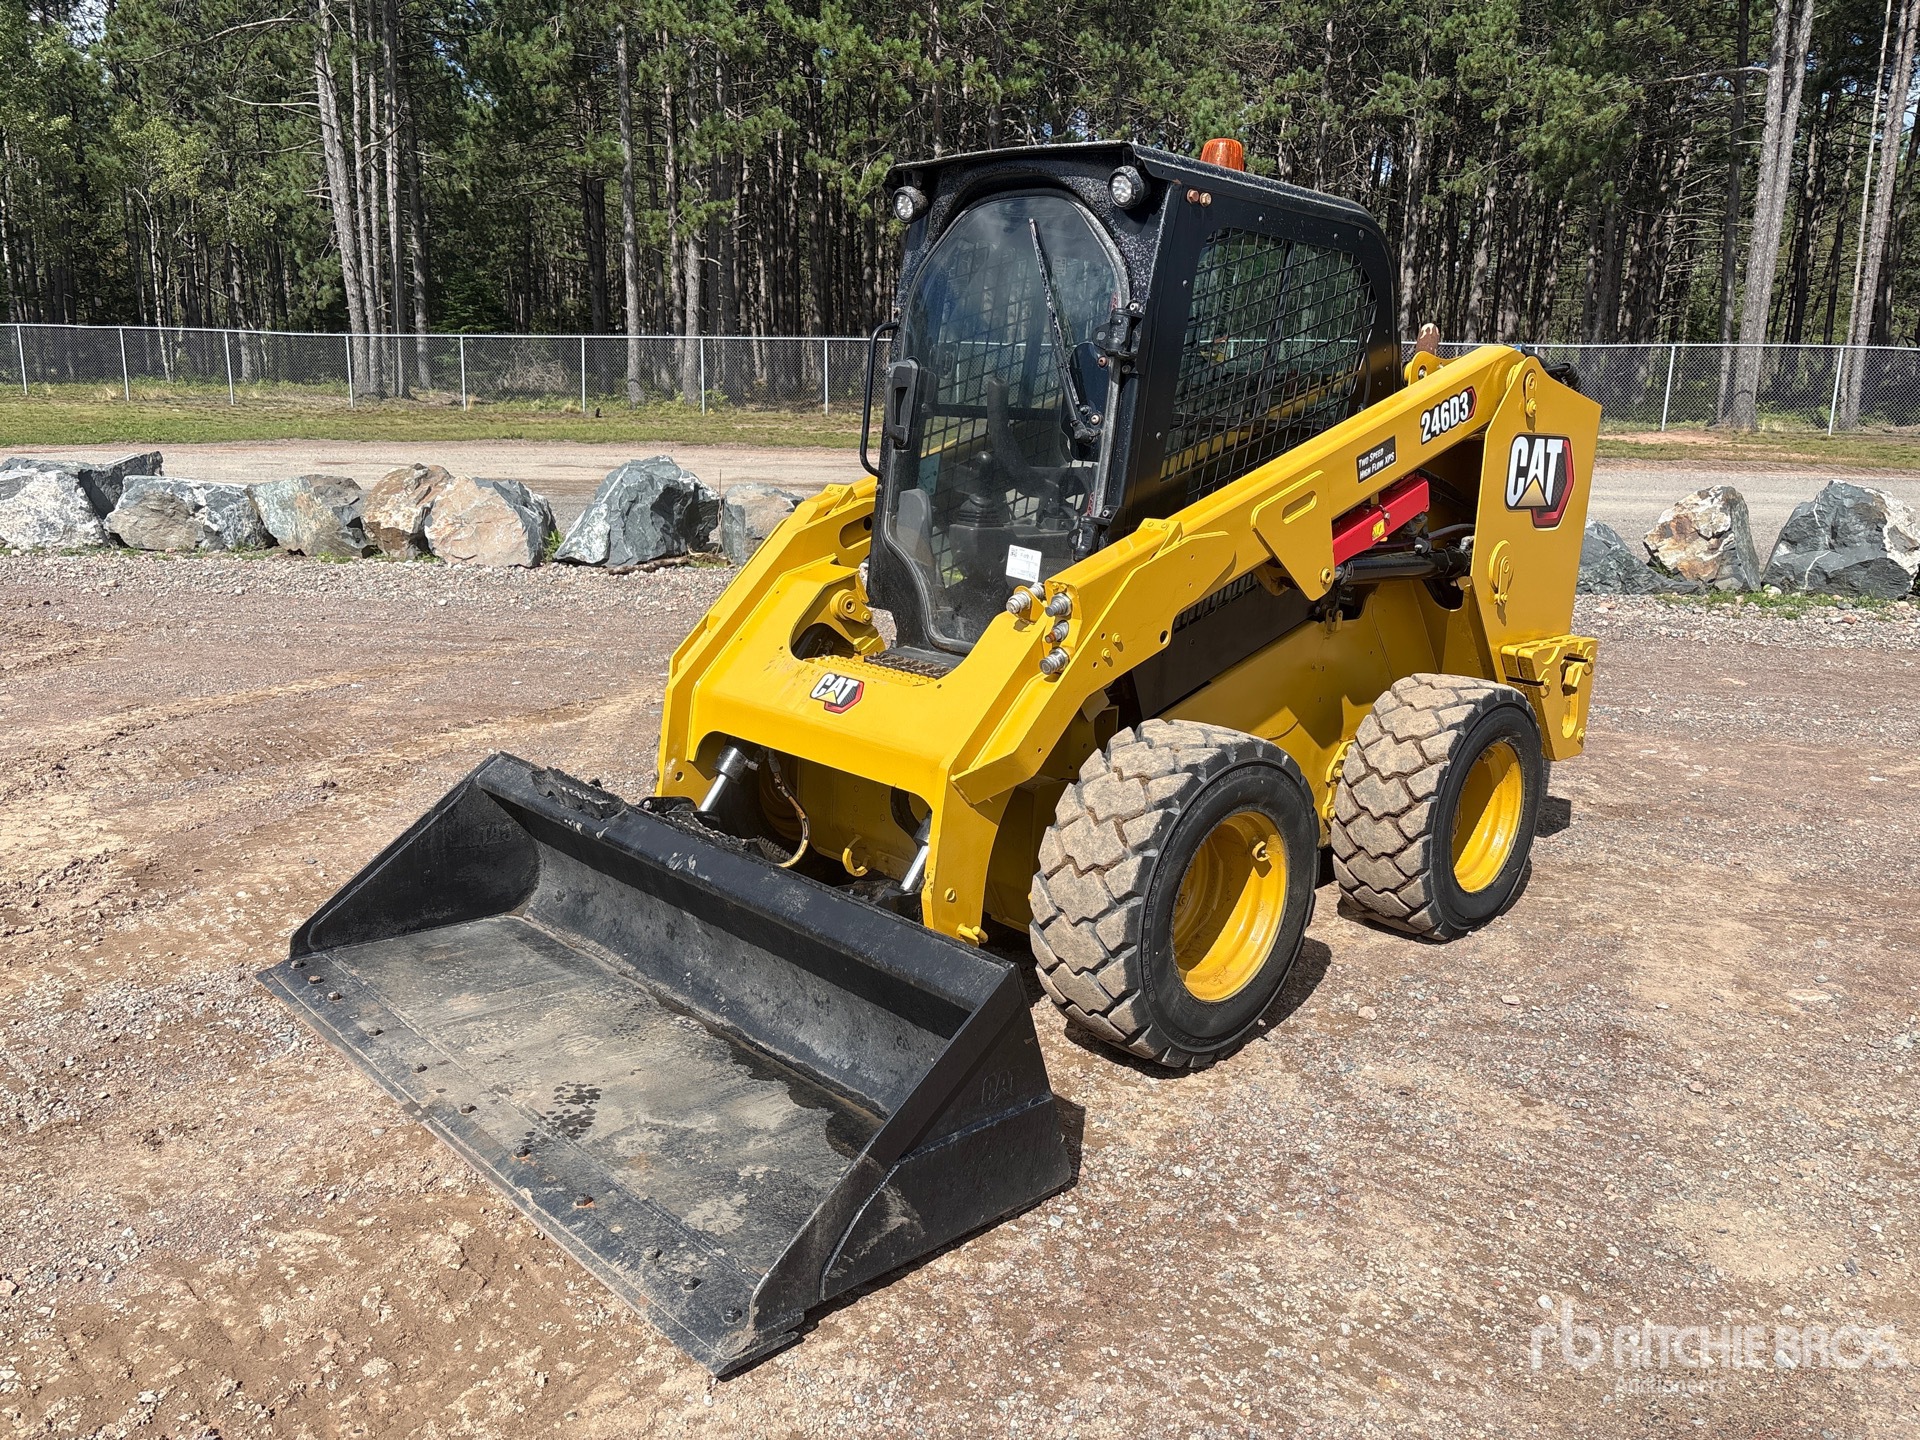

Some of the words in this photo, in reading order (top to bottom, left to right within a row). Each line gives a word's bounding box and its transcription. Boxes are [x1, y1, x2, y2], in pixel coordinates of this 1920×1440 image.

[1421, 391, 1469, 443] 246D3
[1384, 452, 1394, 465] XPS
[1506, 436, 1564, 508] CAT
[810, 673, 860, 705] CAT
